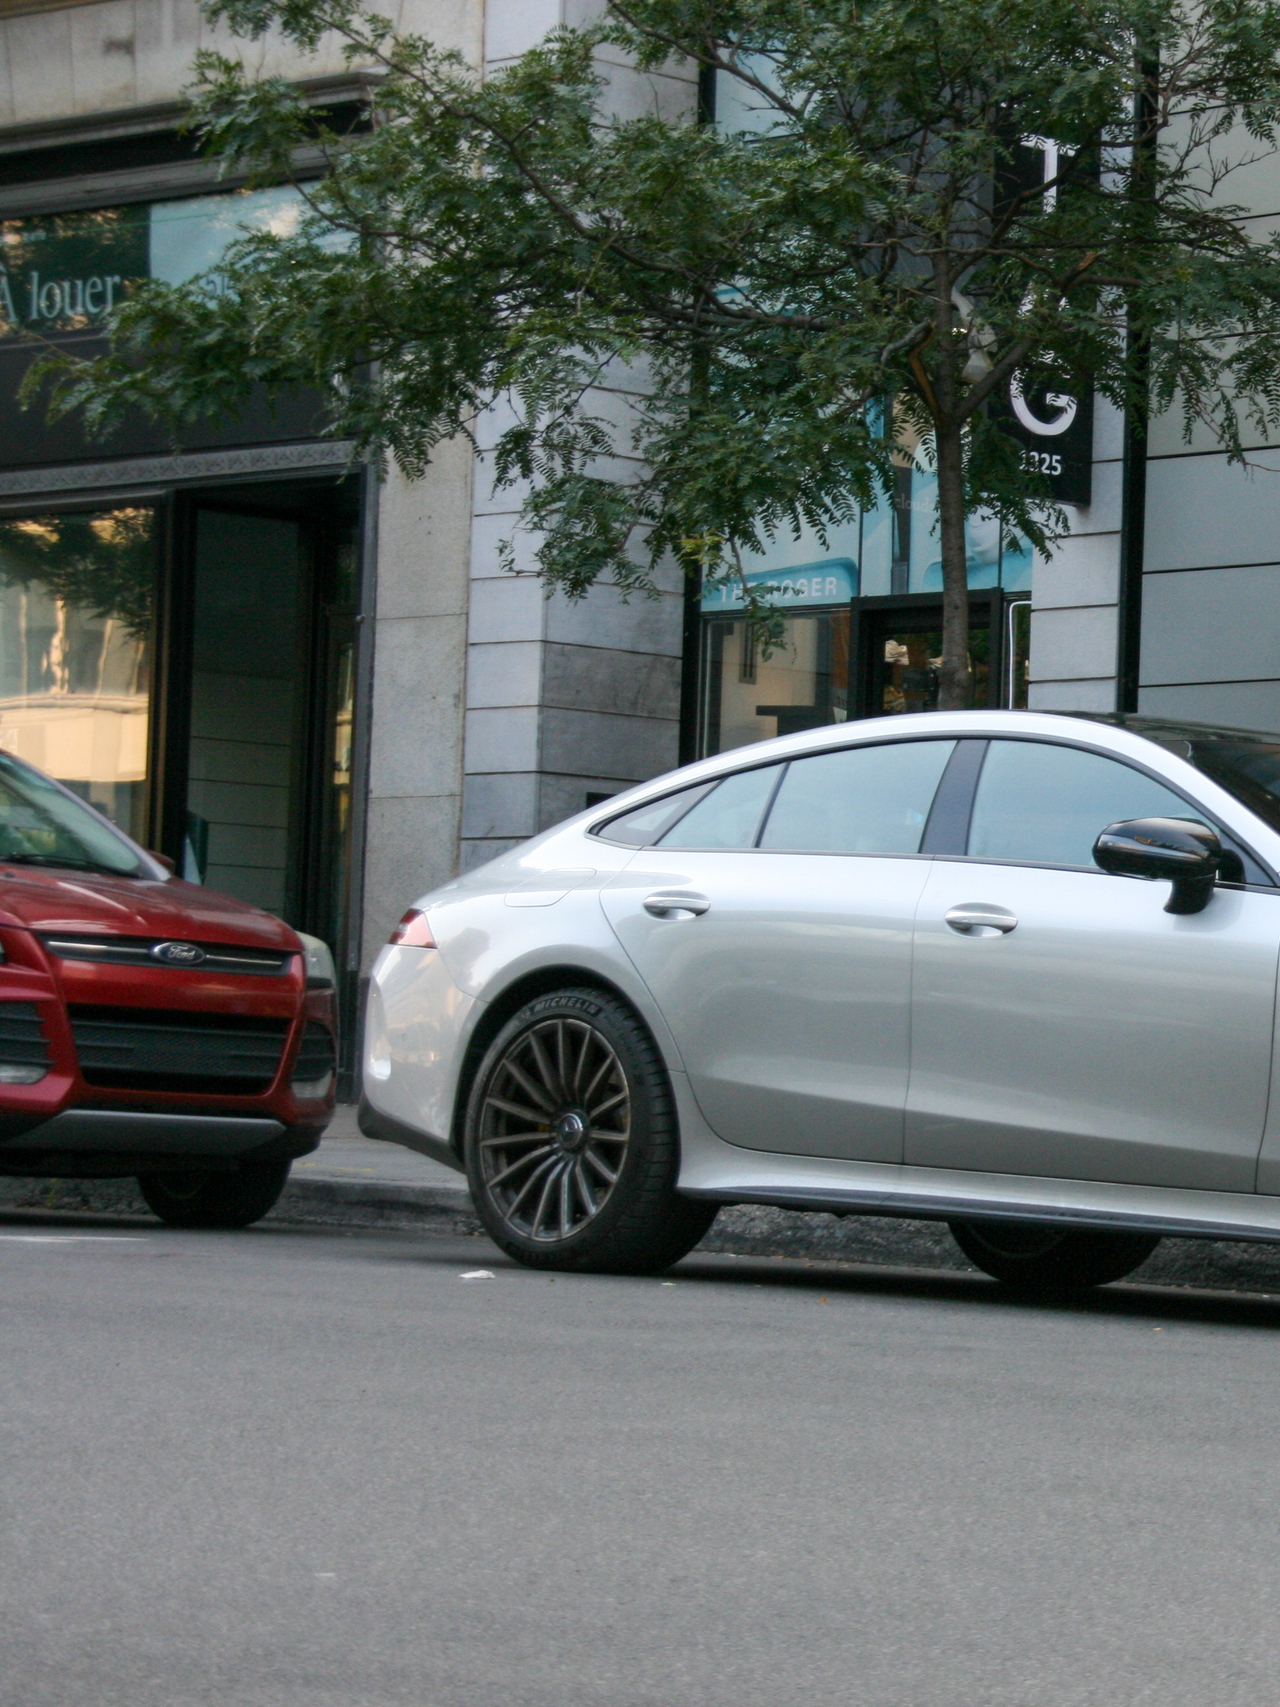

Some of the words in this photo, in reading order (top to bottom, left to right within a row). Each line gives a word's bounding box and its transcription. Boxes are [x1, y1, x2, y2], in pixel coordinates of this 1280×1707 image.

[31, 271, 121, 320] louer
[168, 944, 195, 960] Ford
[534, 997, 599, 1014] MICHELIN
